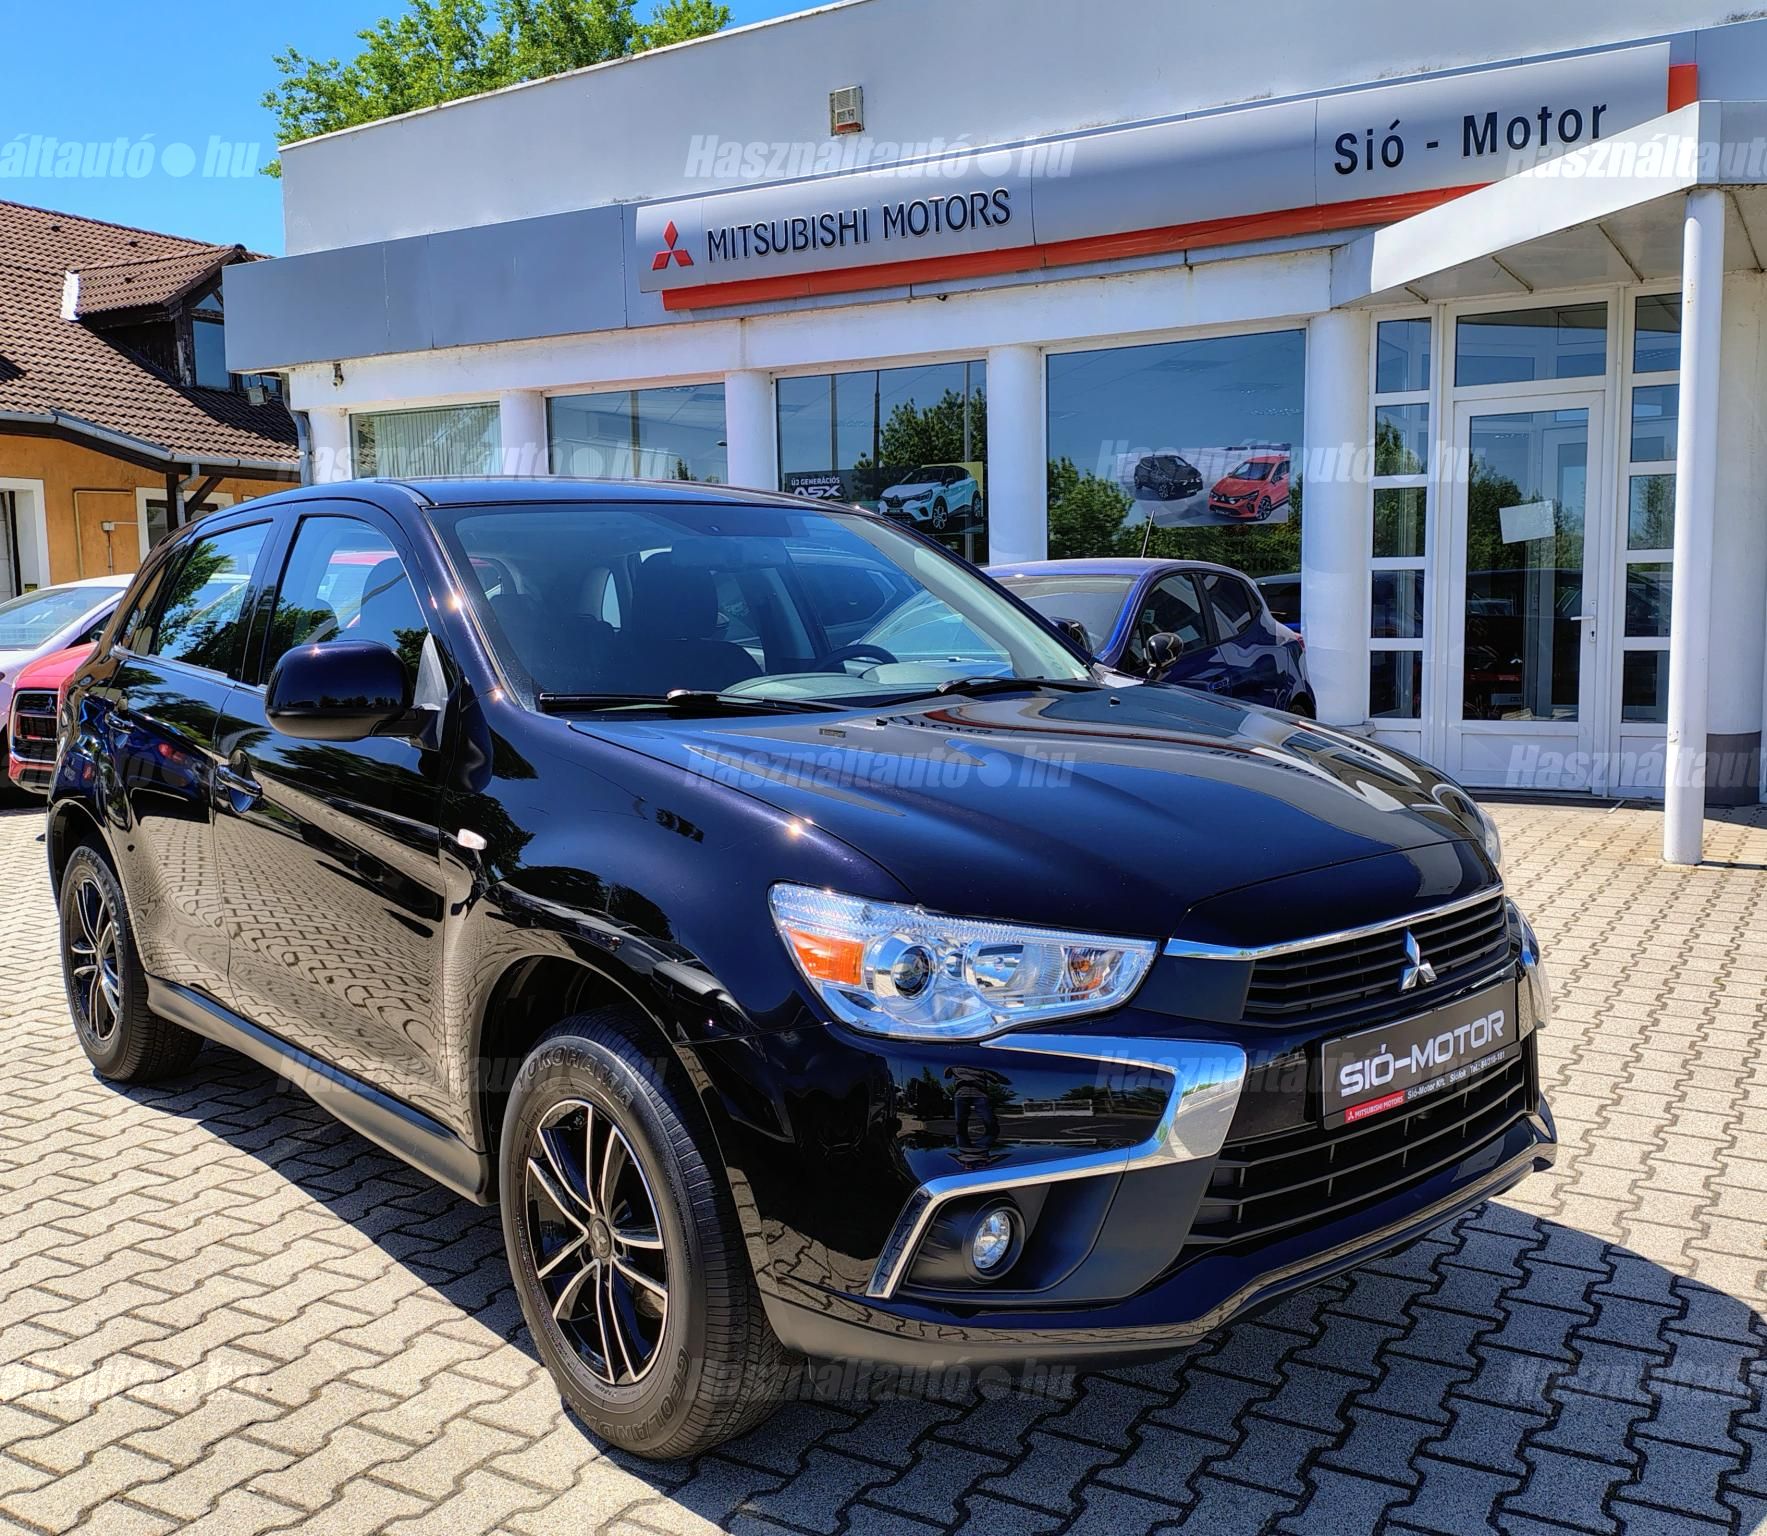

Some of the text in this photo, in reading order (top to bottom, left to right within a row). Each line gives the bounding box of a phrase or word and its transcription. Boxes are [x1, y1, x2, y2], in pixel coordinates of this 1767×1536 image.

[1334, 119, 1405, 176] Sió
[1462, 103, 1607, 158] Motor
[706, 188, 1012, 263] MITSUBISHI MOTORS
[793, 485, 842, 499] ASX
[800, 475, 840, 485] GENERÁCIÓS
[517, 1044, 635, 1112] YOKOHAMA
[1339, 1009, 1505, 1098] SIÓ-MOTOR
[1354, 1095, 1404, 1119] MITSUBISHI MOTORS
